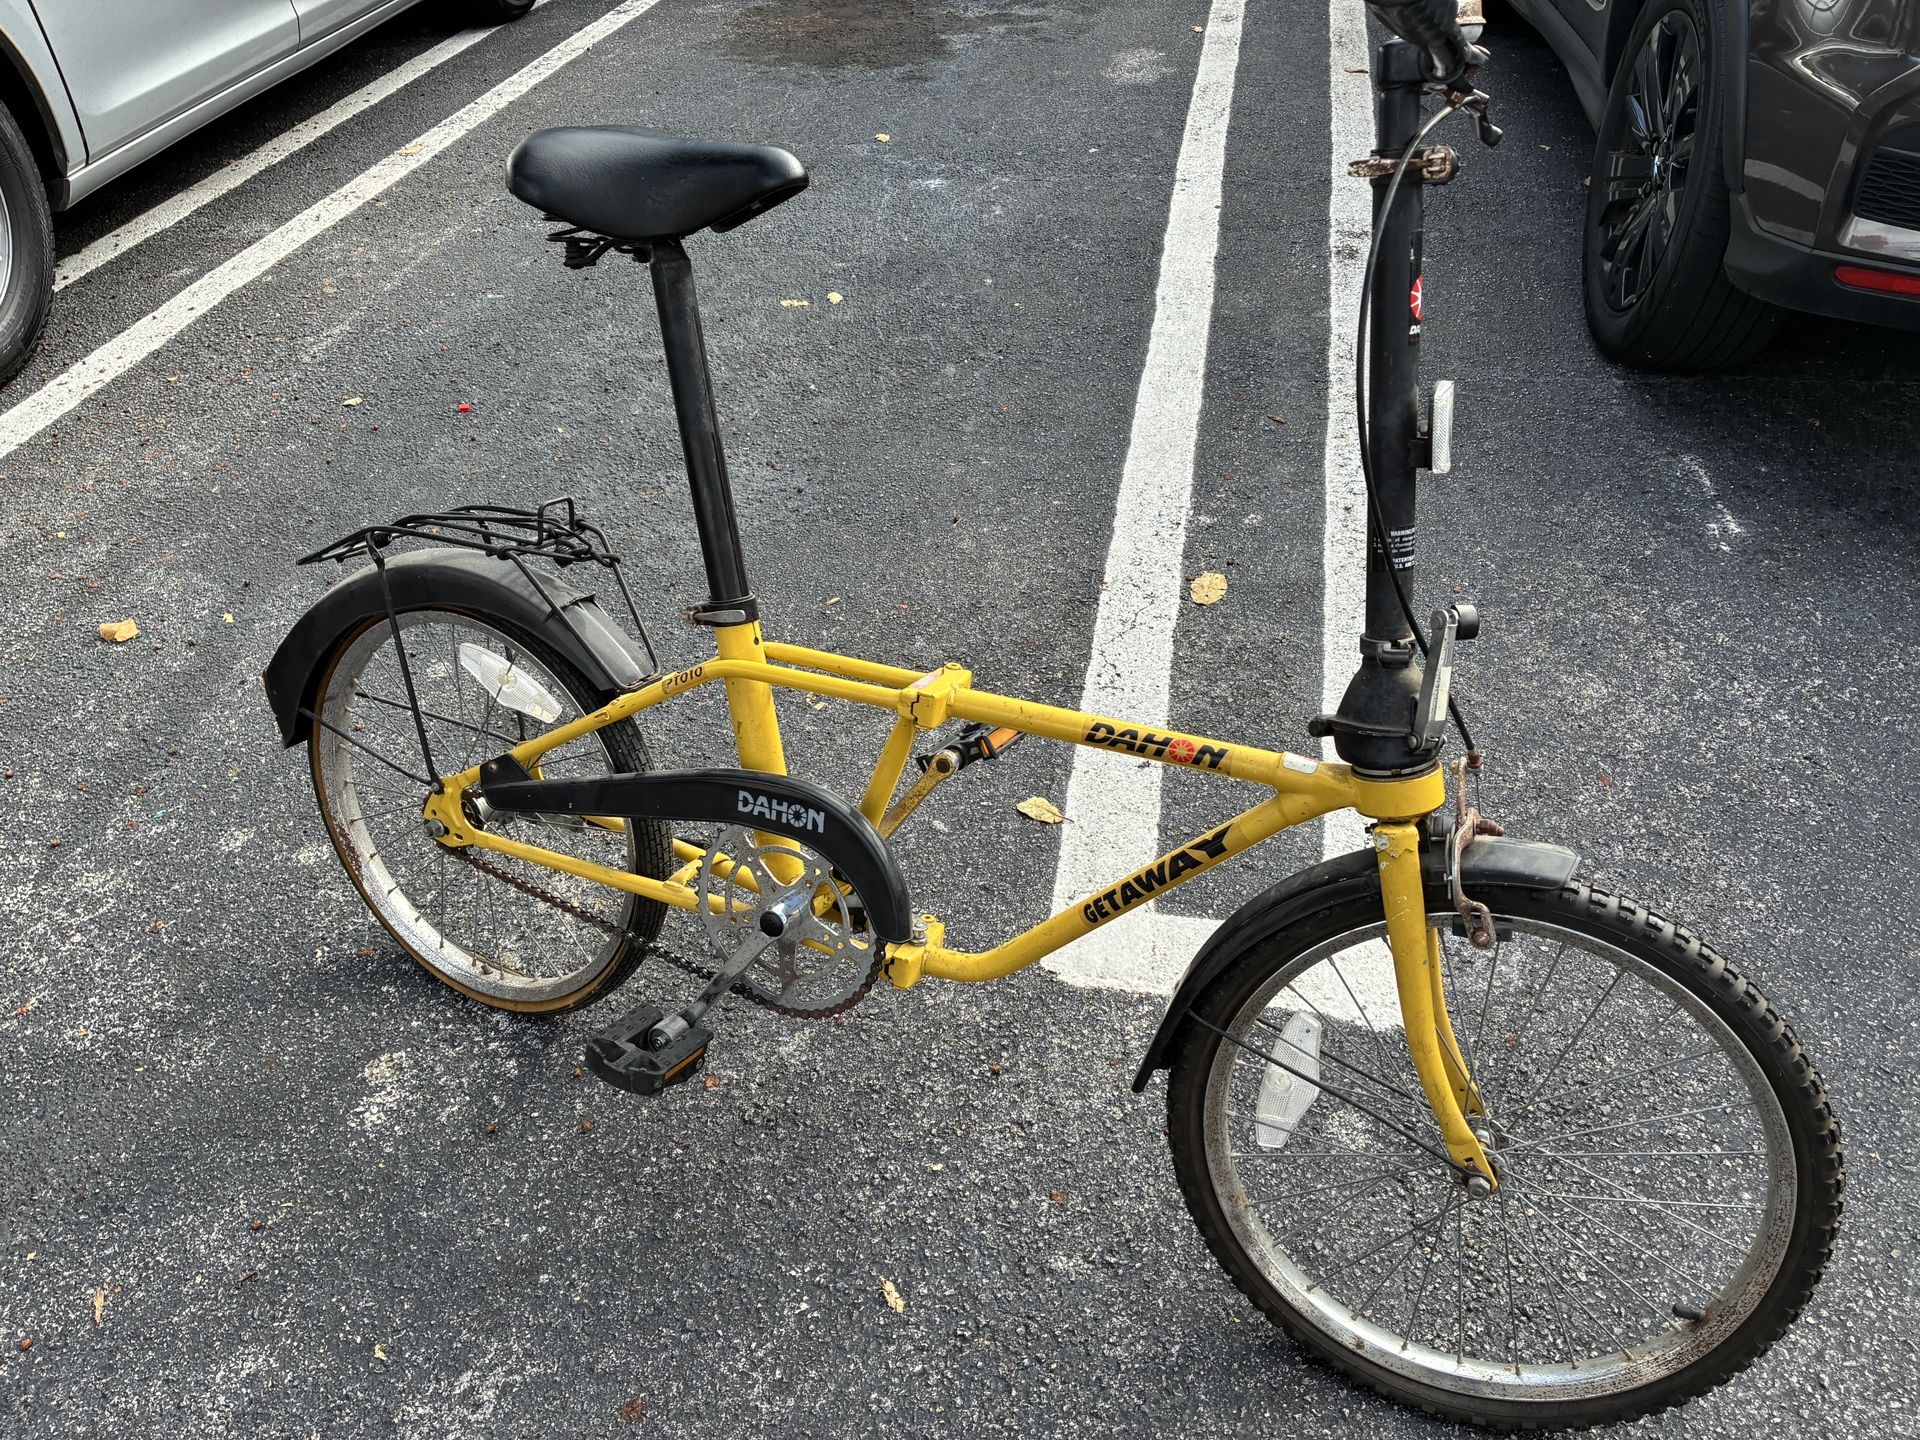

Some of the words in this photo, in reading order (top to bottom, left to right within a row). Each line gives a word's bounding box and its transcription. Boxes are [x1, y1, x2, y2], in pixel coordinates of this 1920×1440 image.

[1084, 722, 1229, 770] DAHON
[737, 790, 826, 833] DAHON
[1083, 823, 1234, 924] GETAWAY
